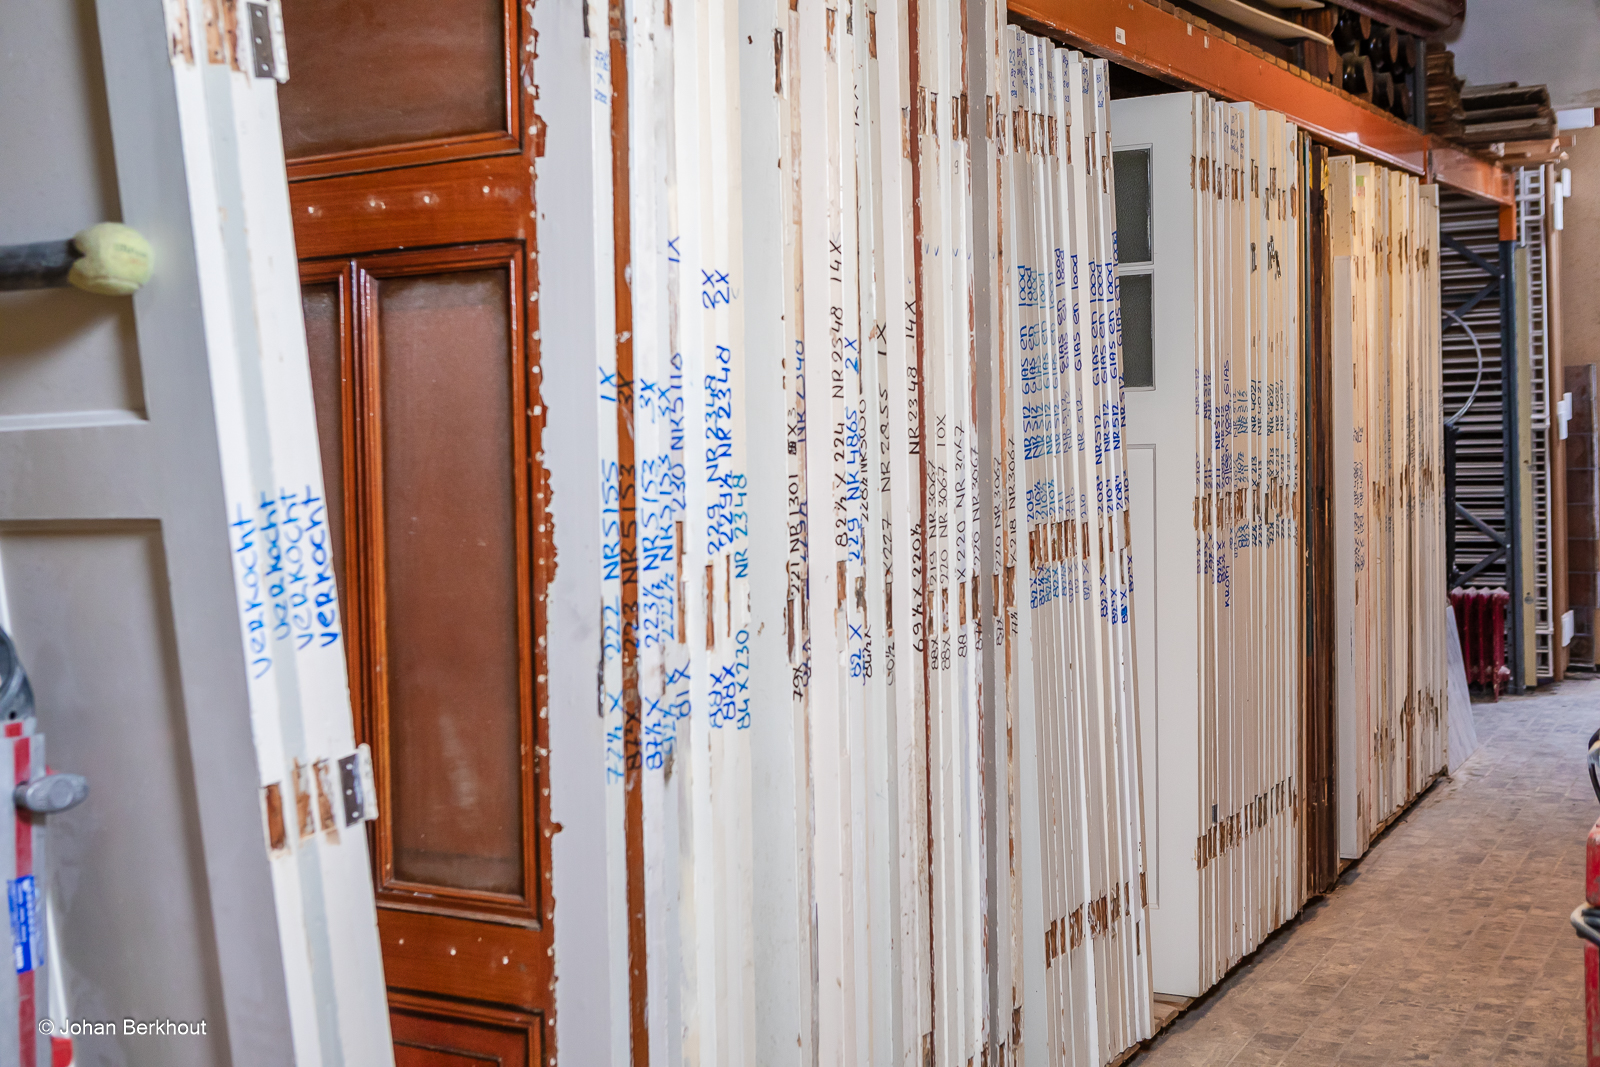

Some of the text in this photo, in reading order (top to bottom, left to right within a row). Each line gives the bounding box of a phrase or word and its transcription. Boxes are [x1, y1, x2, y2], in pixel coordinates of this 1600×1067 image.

[833, 422, 846, 461] 224
[670, 462, 686, 510] 230
[603, 595, 622, 661] 222
[735, 628, 749, 675] 230
